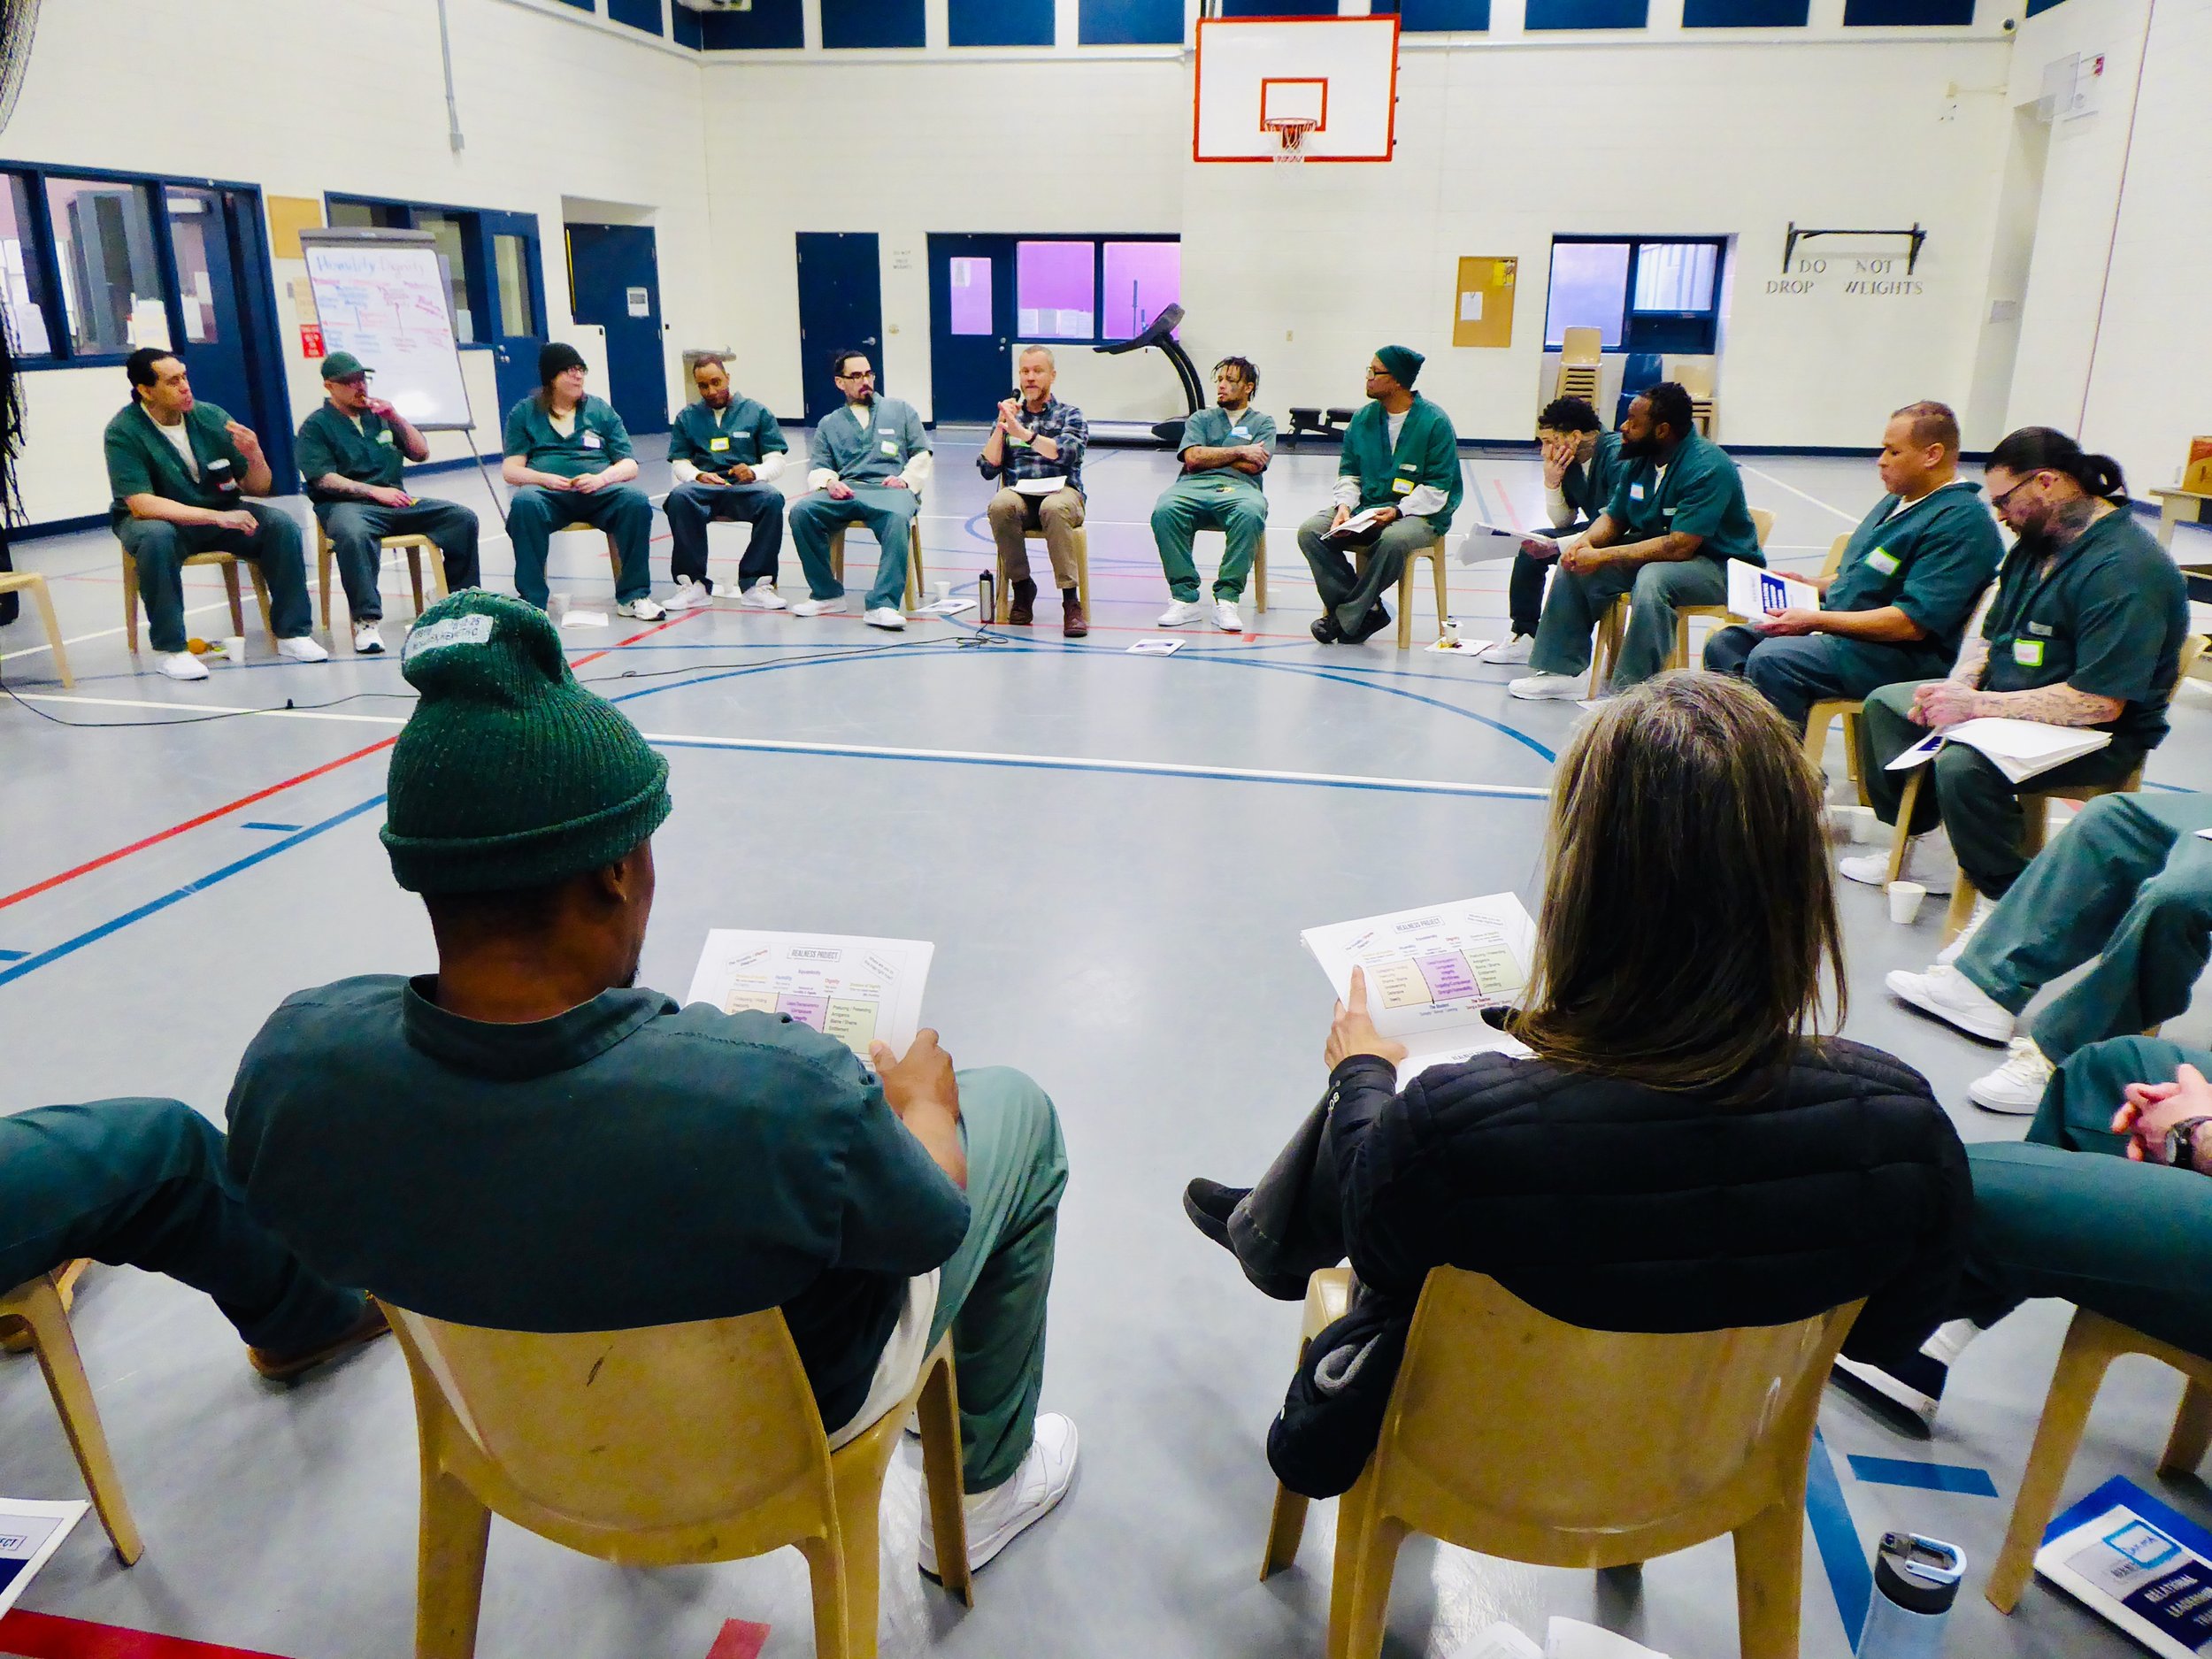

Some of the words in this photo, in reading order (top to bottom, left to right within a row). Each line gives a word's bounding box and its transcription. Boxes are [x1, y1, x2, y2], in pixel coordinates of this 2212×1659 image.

[1800, 258, 1827, 273] DO
[1856, 258, 1893, 273] NOT
[1765, 280, 1815, 295] DROP
[1845, 280, 1924, 296] WEIGHTS
[791, 949, 816, 958] REALNESS
[817, 949, 839, 959] PROJECT
